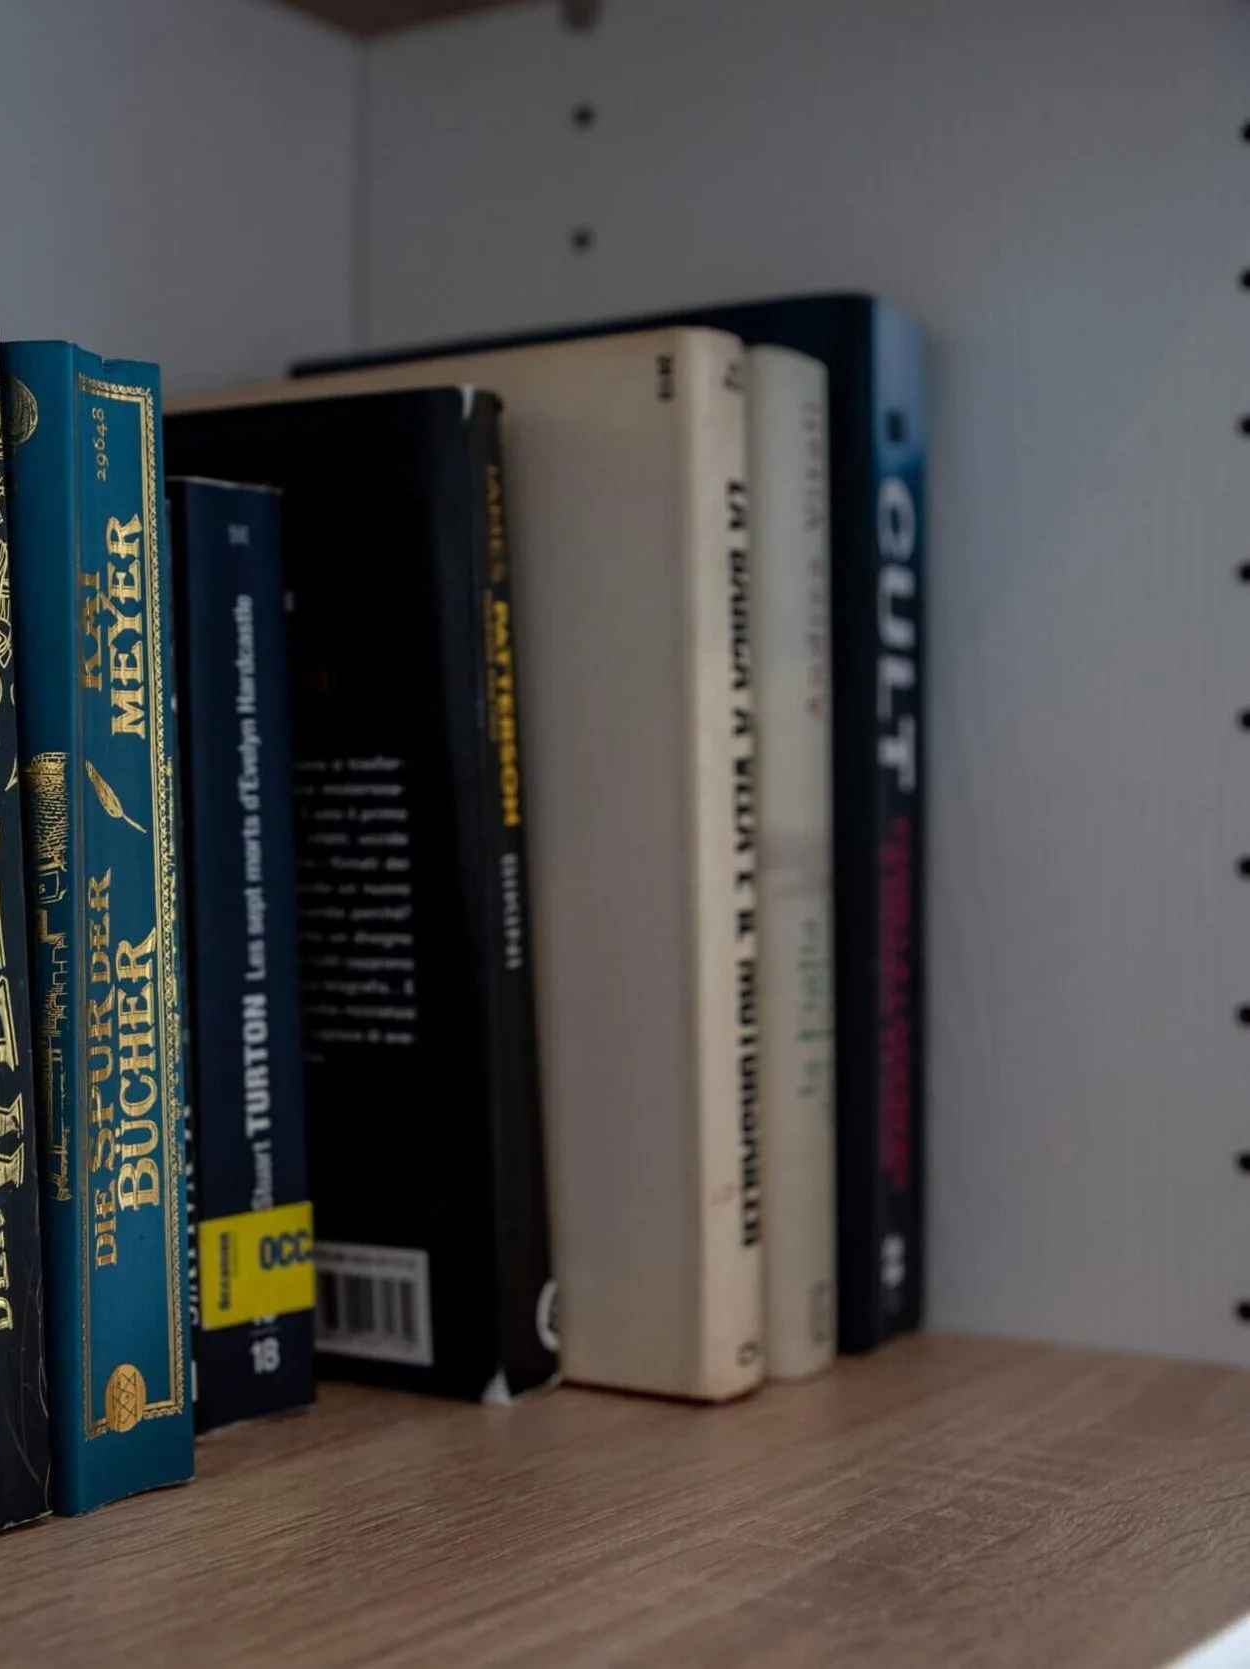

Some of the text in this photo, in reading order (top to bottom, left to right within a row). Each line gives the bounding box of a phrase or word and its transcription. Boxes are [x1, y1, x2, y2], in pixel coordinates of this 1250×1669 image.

[91, 407, 108, 482] 29648
[80, 570, 102, 690] KAI
[106, 513, 147, 740] MEYER
[492, 600, 522, 828] PATTERSON
[877, 476, 918, 793] CULT
[231, 594, 274, 1211] Stuart TURTON Les sept morts d'Evelyn Hardcastle
[501, 852, 523, 970] BIKINI
[87, 868, 118, 1268] DIE SPUR DER
[116, 925, 161, 1211] BÜCHER
[250, 1336, 281, 1375] 18
